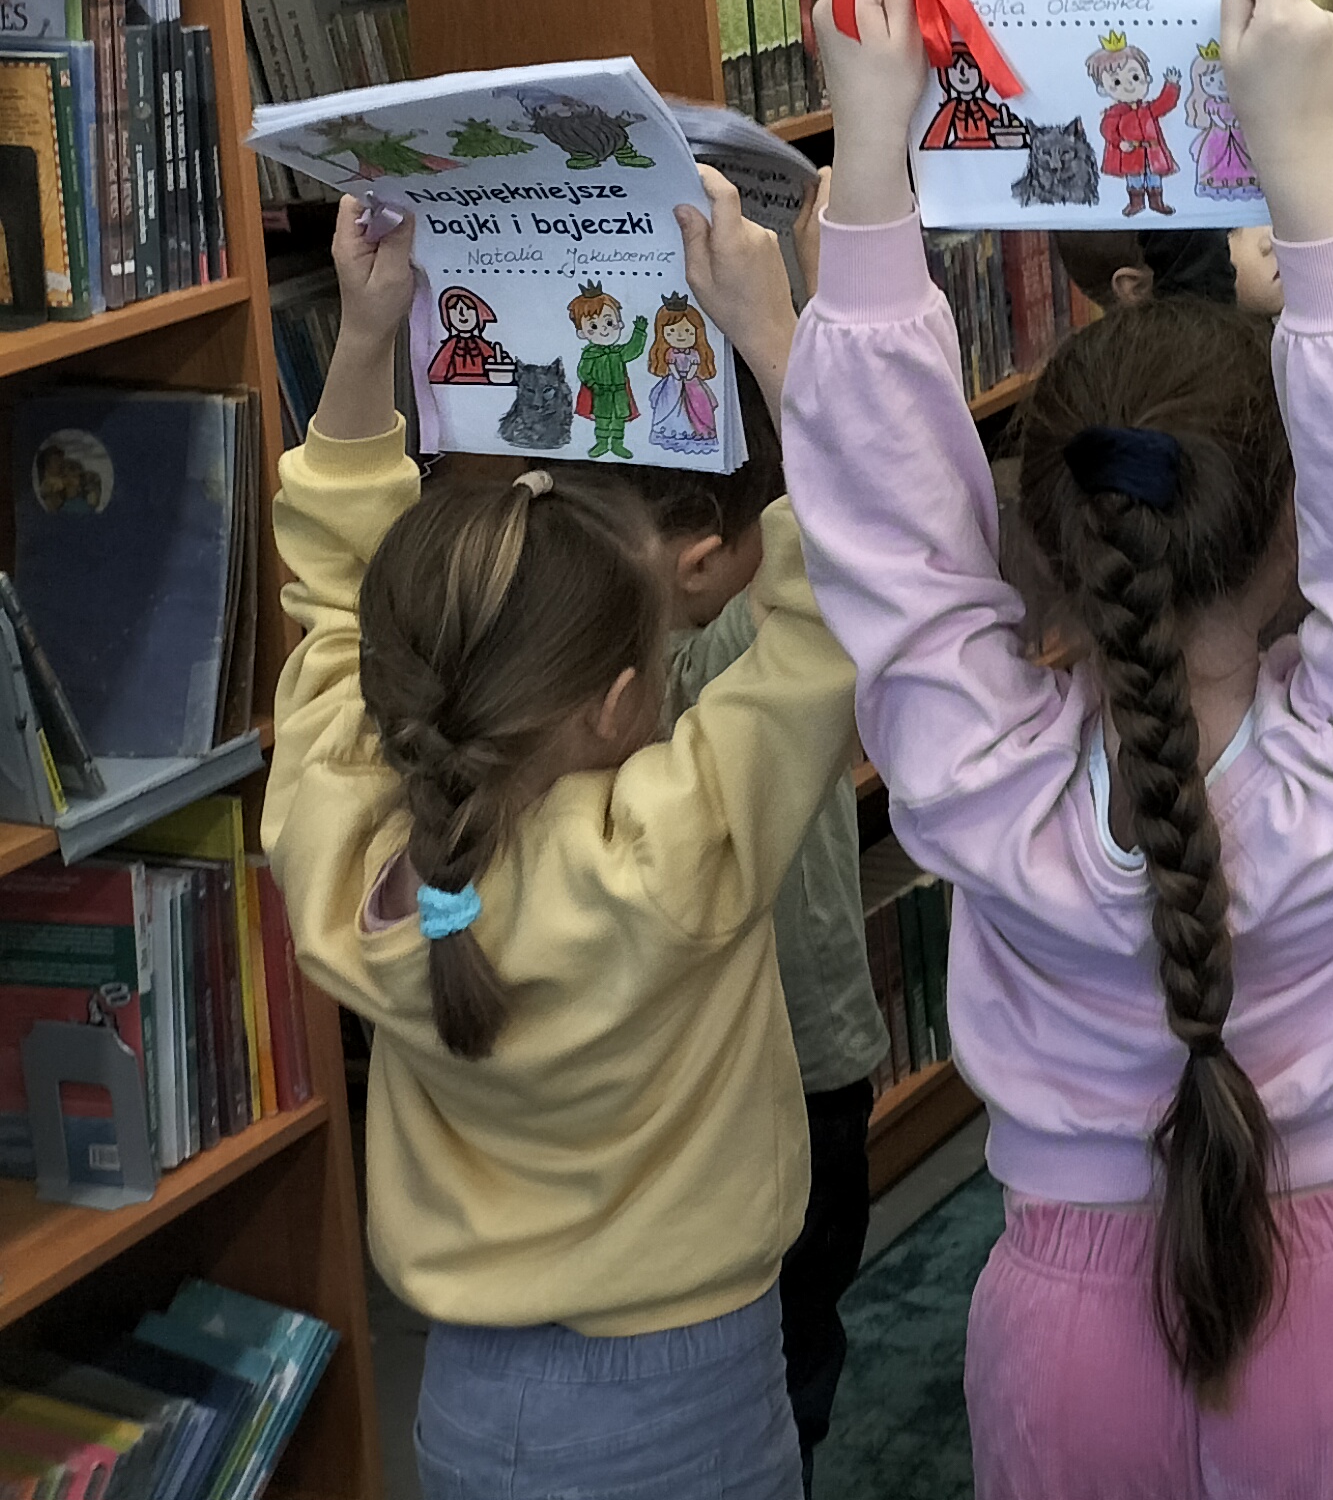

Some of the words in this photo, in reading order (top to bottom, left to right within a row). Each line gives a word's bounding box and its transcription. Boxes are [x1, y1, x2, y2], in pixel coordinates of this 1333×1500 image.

[405, 182, 628, 207] Najpiękniejsze
[426, 213, 501, 241] bajki
[512, 213, 522, 235] i
[531, 212, 654, 241] bajeczki
[468, 244, 543, 266] Natalia
